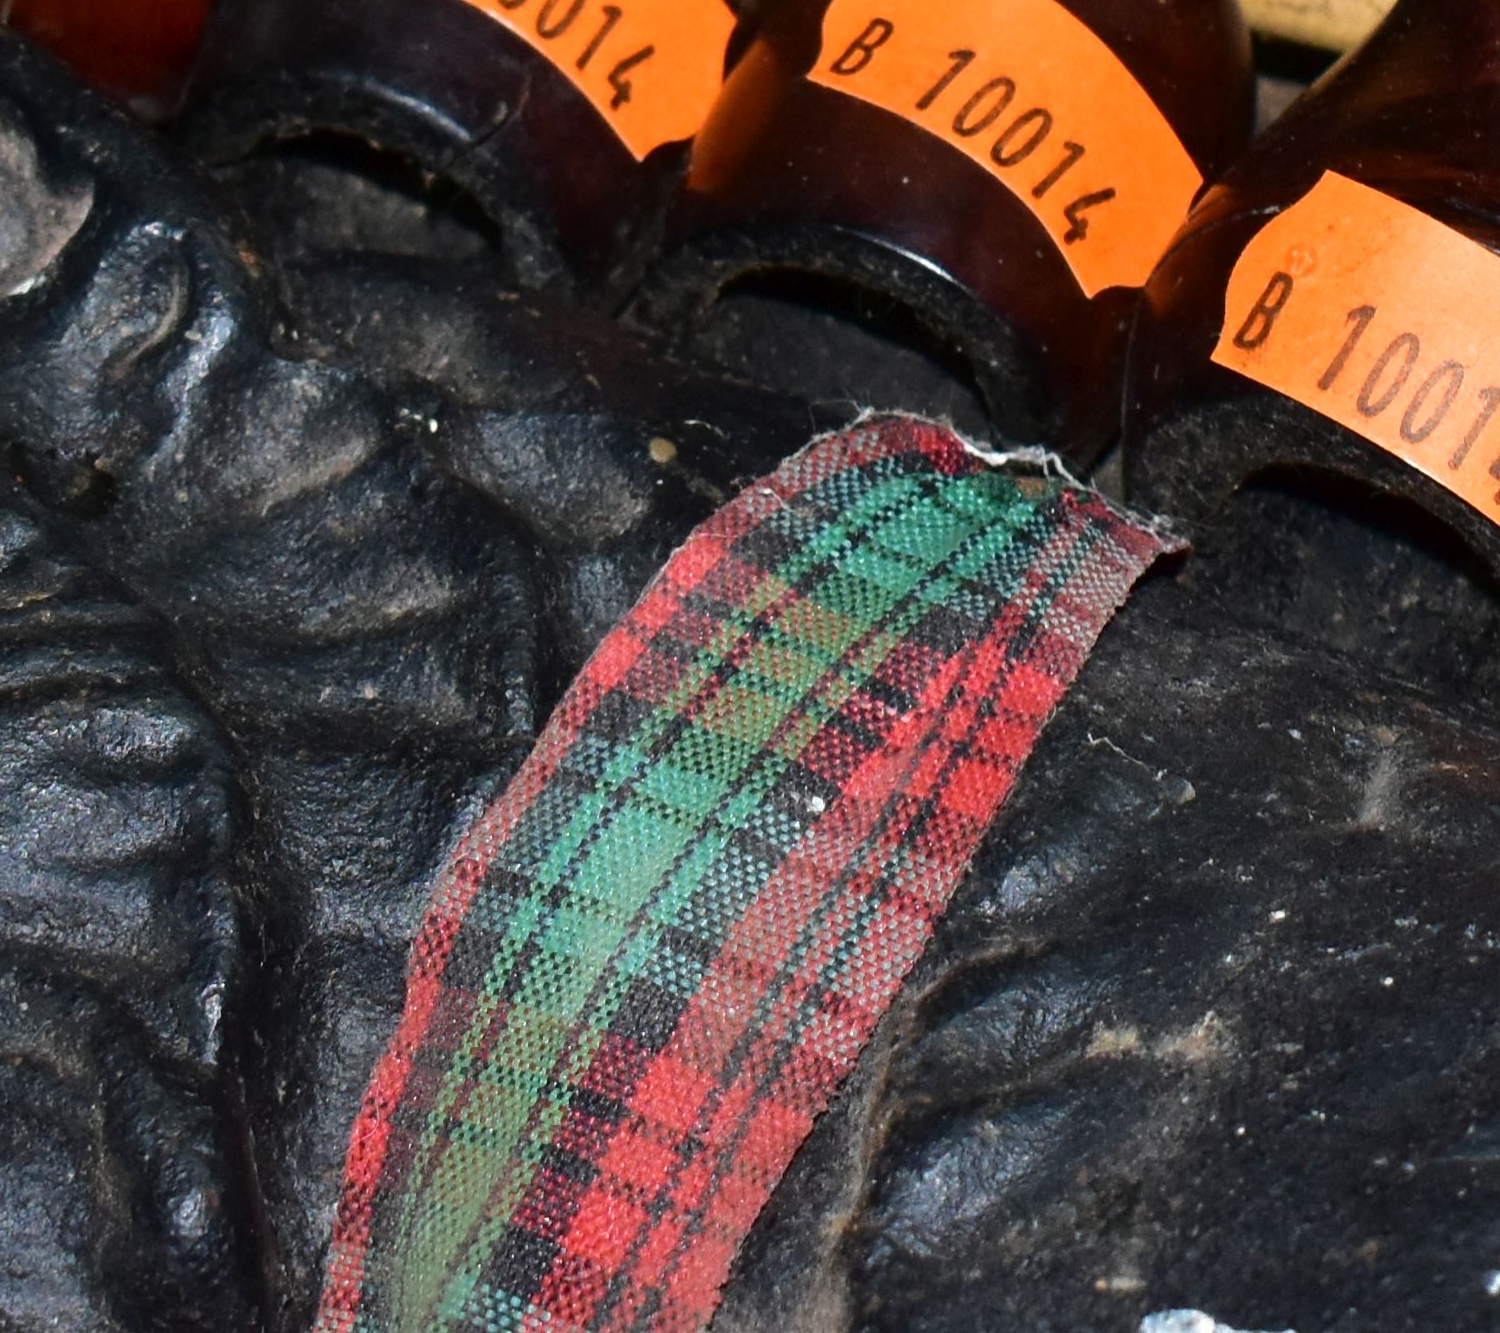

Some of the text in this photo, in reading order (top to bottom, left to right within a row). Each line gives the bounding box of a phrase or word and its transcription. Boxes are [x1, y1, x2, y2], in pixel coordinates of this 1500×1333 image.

[829, 17, 1117, 244] B 10014
[1232, 271, 1294, 350] B
